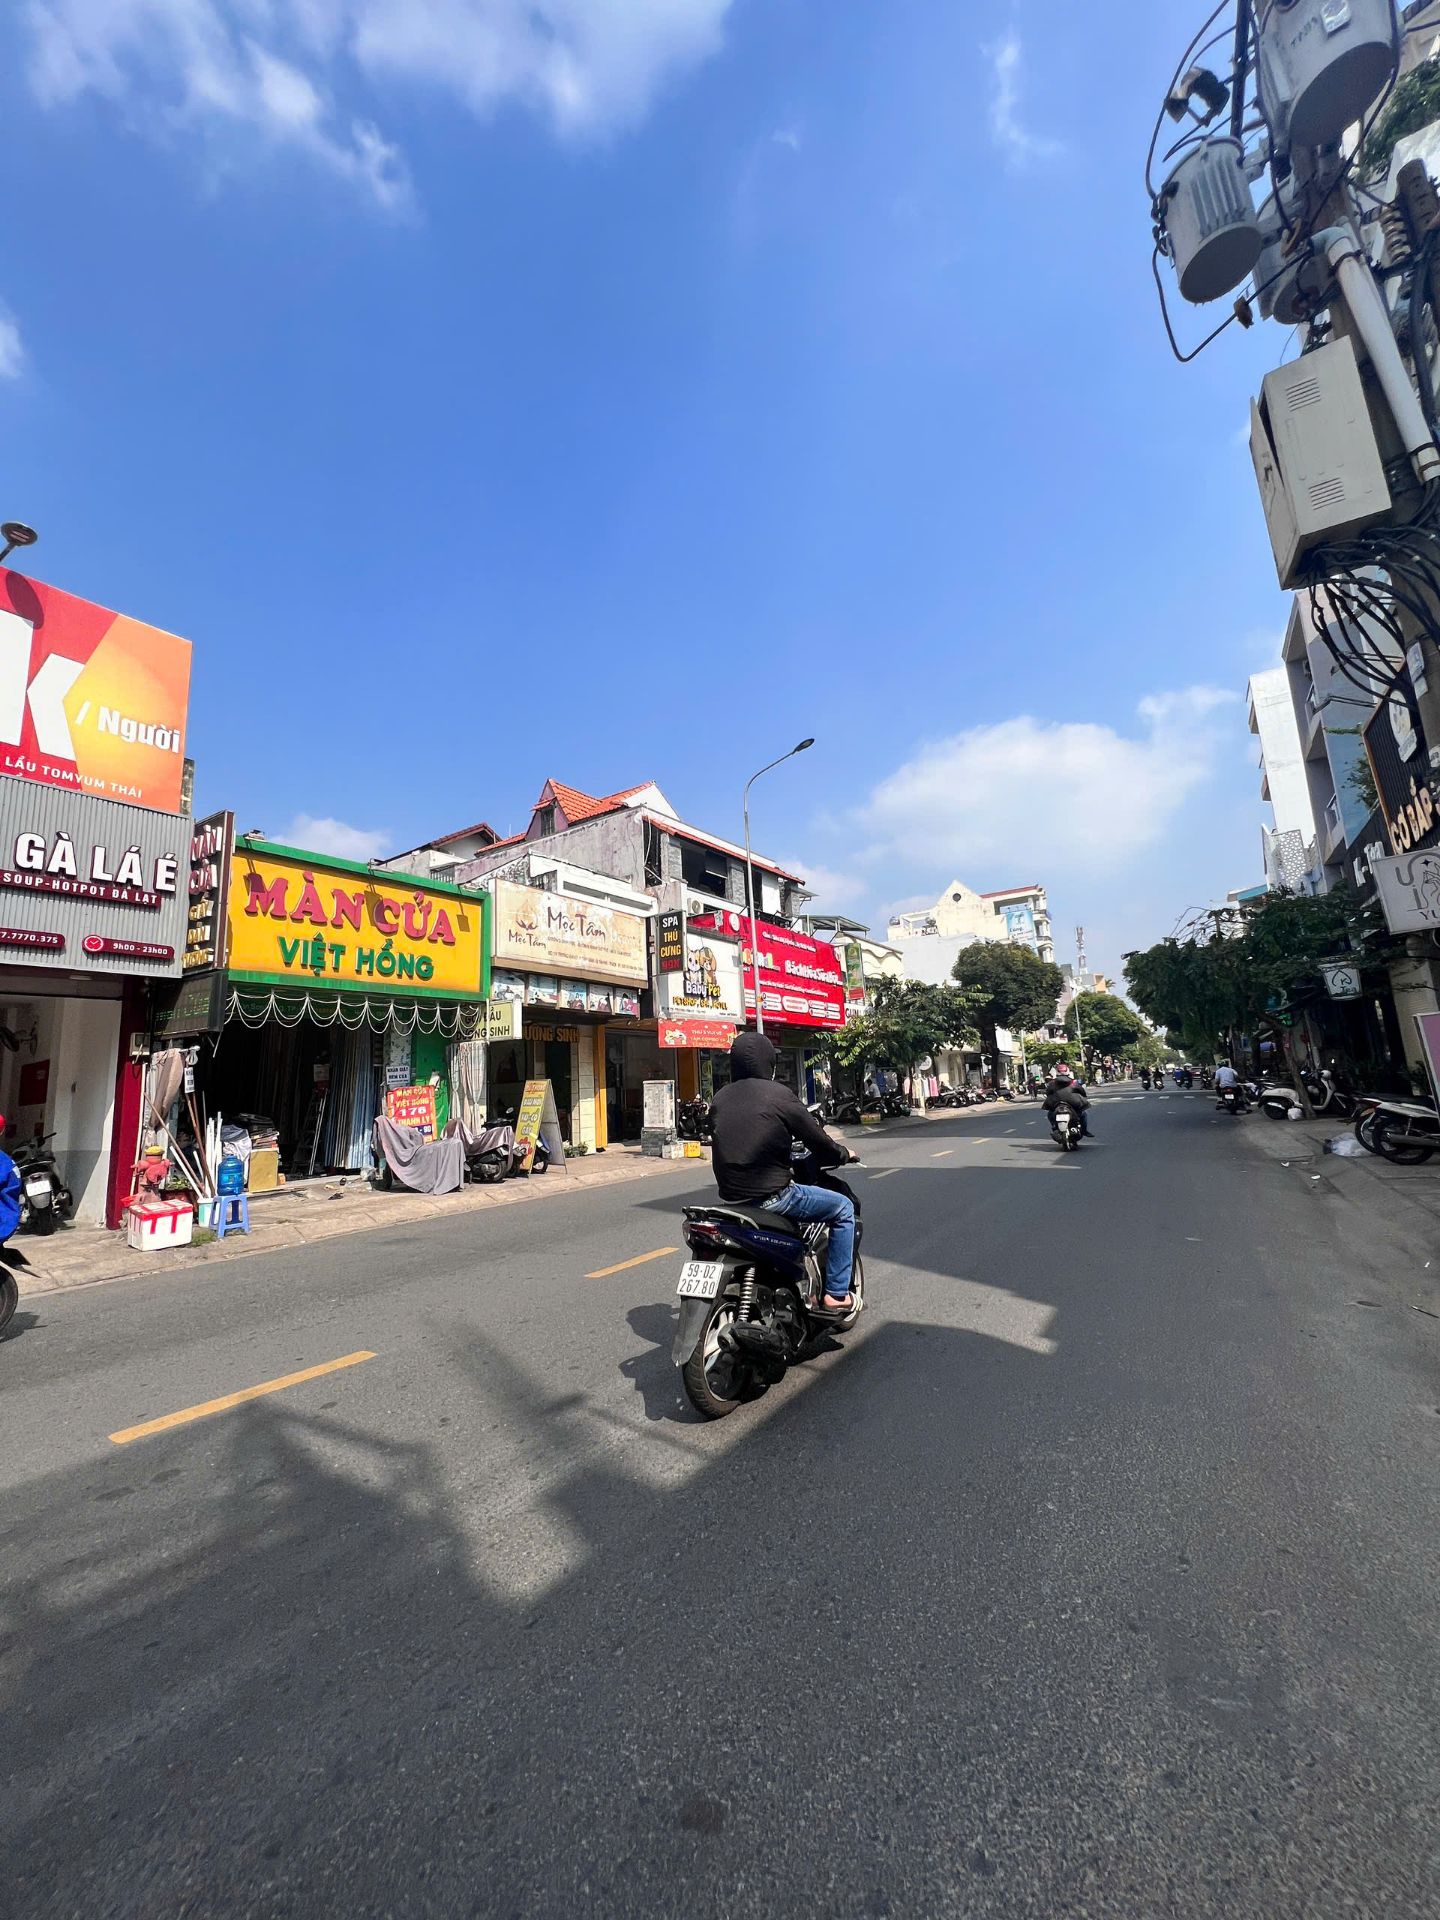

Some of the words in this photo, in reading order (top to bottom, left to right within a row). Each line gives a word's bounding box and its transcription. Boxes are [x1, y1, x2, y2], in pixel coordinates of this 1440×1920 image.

[98, 705, 181, 753] Người
[5, 756, 36, 772] LẨU
[42, 765, 105, 789] TOMYUM
[111, 781, 142, 799] THÁI
[15, 831, 78, 877] GÀ
[91, 845, 144, 887] LÁ
[155, 852, 179, 892] É
[3, 872, 106, 897] SOUP-HOTPOT
[135, 893, 158, 905] LẠT
[244, 870, 365, 930] MÀN
[374, 890, 456, 943] CỬA
[547, 907, 575, 933] Mộc
[575, 913, 607, 942] Tâm
[662, 916, 679, 928] SPA
[508, 929, 526, 947] Mộc
[526, 933, 546, 953] Tâm
[663, 928, 678, 942] THÚ
[113, 943, 135, 951] 9h00
[143, 946, 168, 955] 23h00
[277, 931, 347, 975] VIỆT
[355, 939, 434, 980] HỒNG
[660, 944, 682, 957] CƯNG
[686, 980, 707, 997] Baby
[707, 983, 721, 997] Pet
[489, 1025, 510, 1037] SINH
[399, 1106, 427, 1117] 176
[679, 1279, 716, 1295] 267.80
